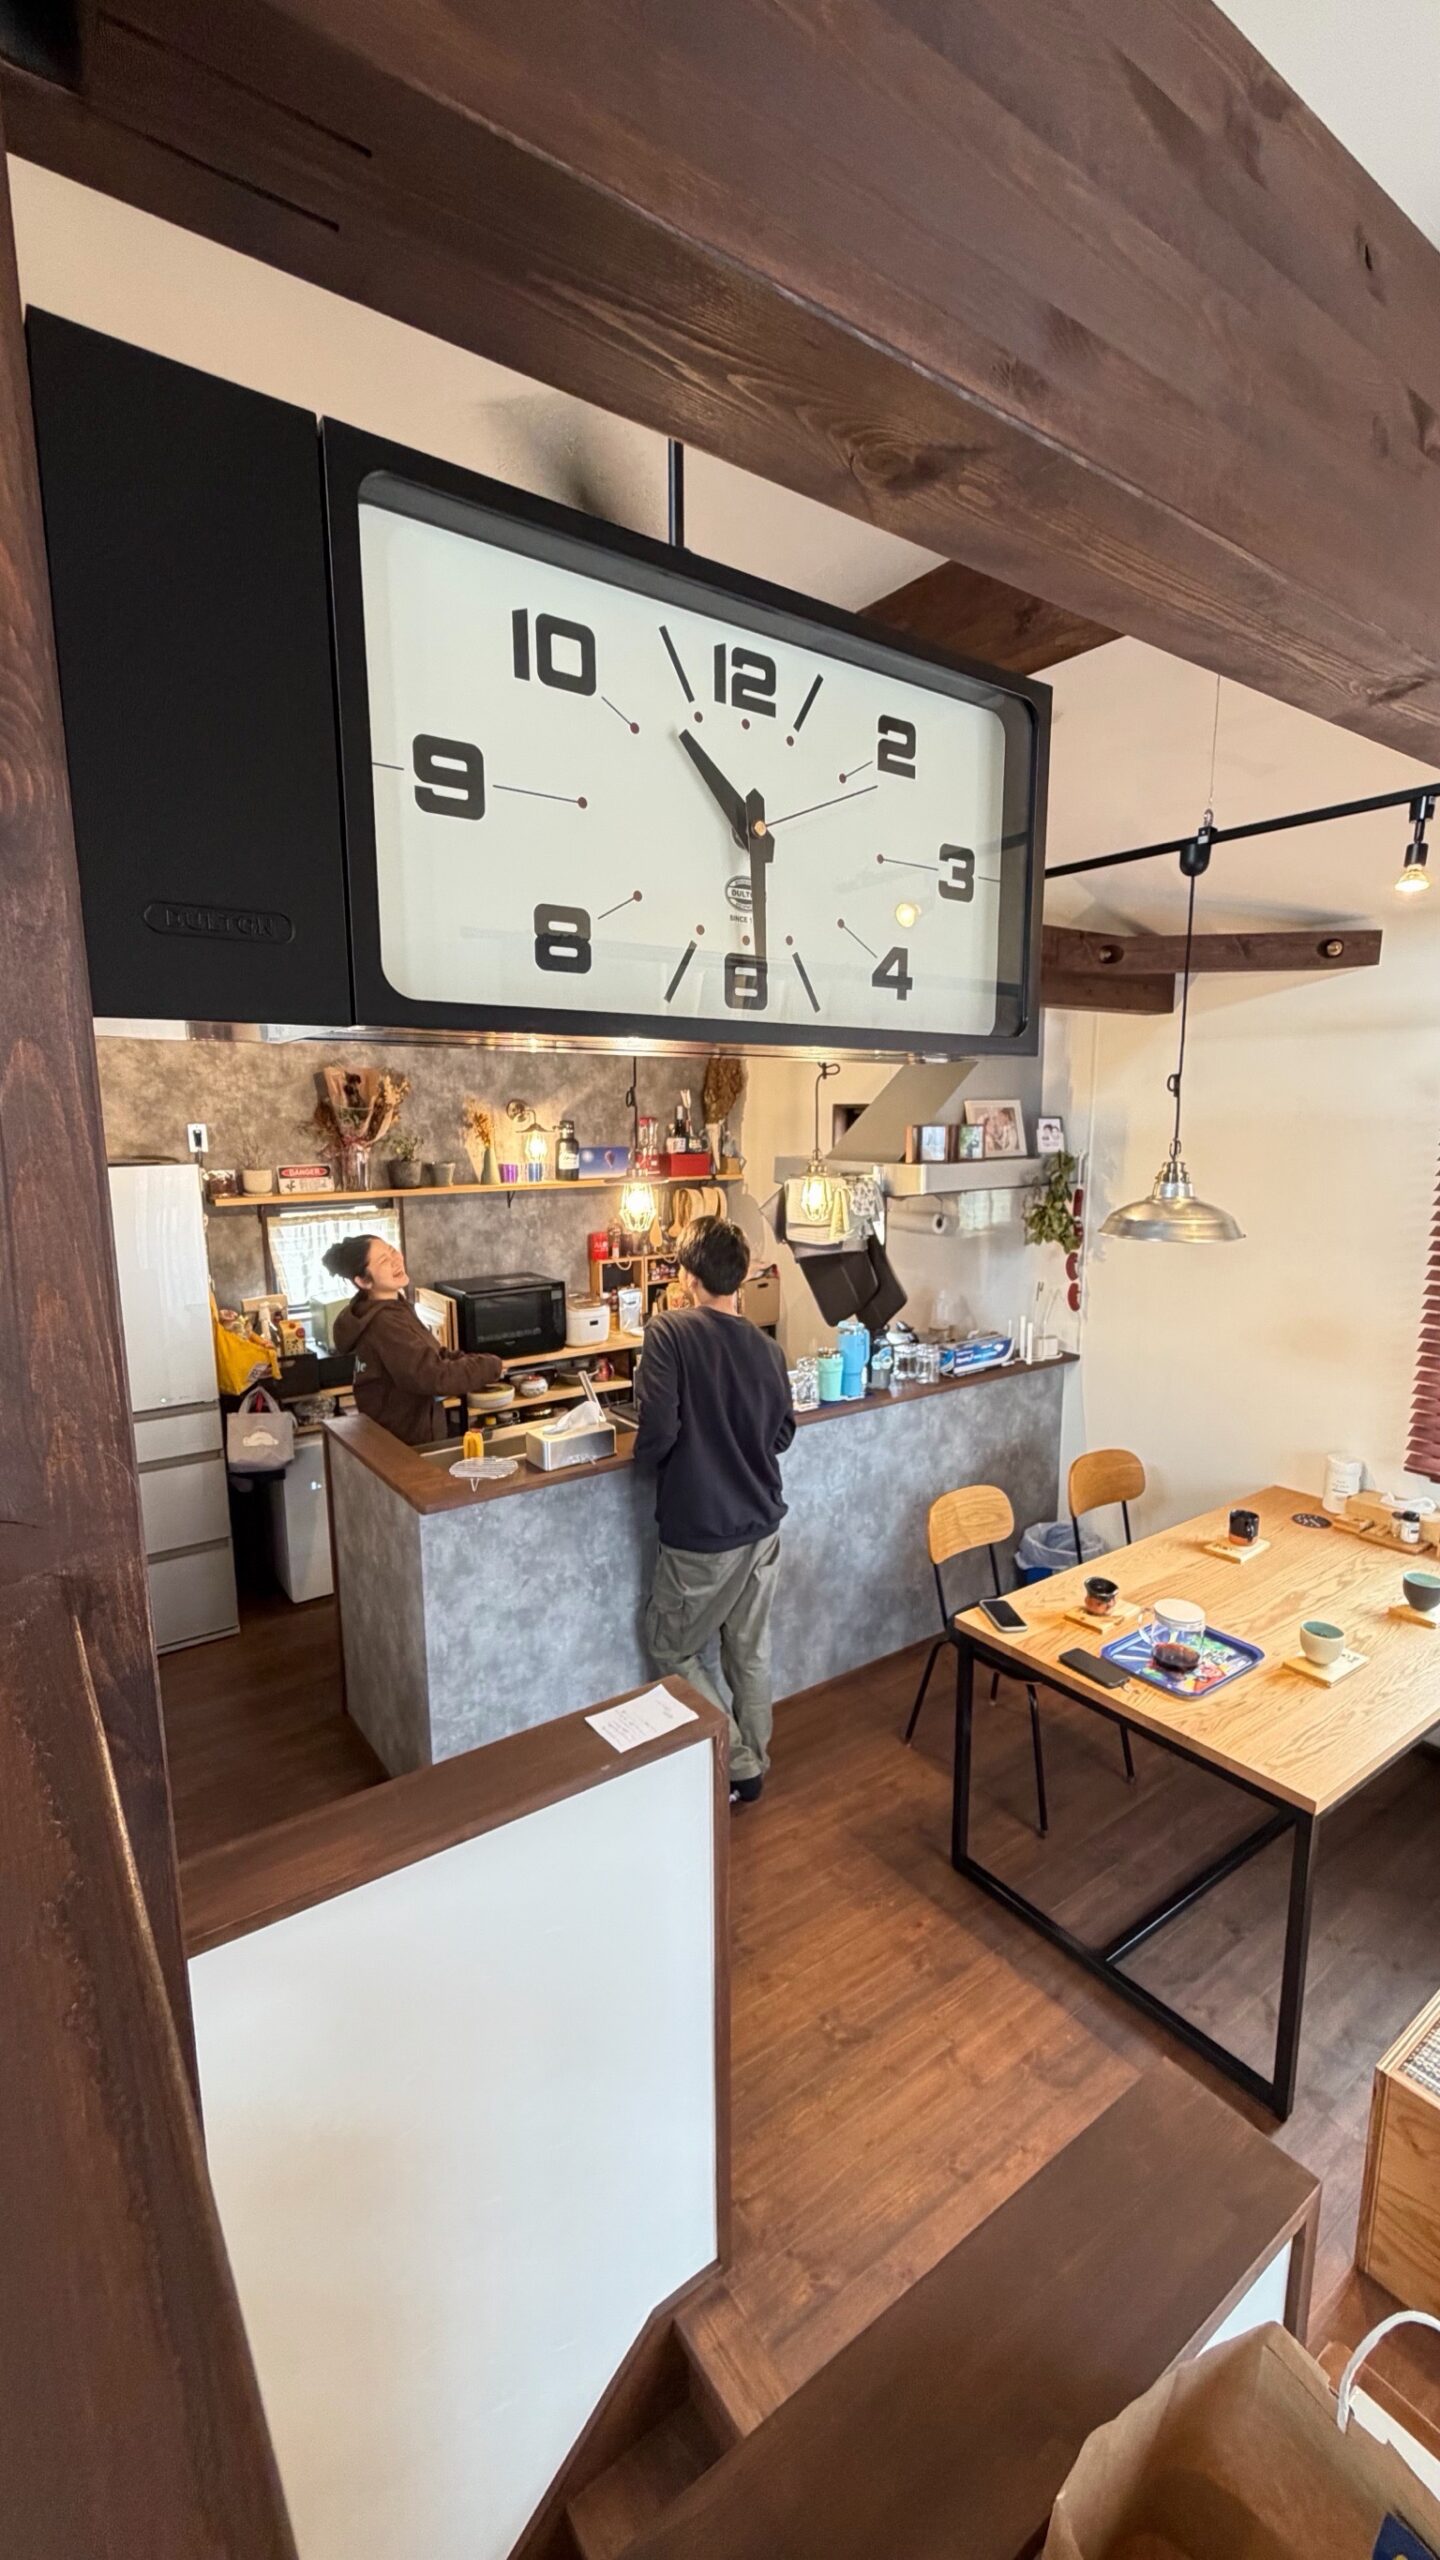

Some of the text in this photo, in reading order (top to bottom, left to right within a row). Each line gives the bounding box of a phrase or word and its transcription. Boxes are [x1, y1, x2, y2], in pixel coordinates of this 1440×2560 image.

[513, 609, 596, 695] 10
[715, 643, 776, 717] 12
[412, 734, 485, 820] 9
[878, 714, 915, 779] 2
[939, 843, 975, 902] 3
[534, 903, 592, 974] 8
[872, 947, 913, 1000] 4
[289, 1167, 320, 1177] DANGER
